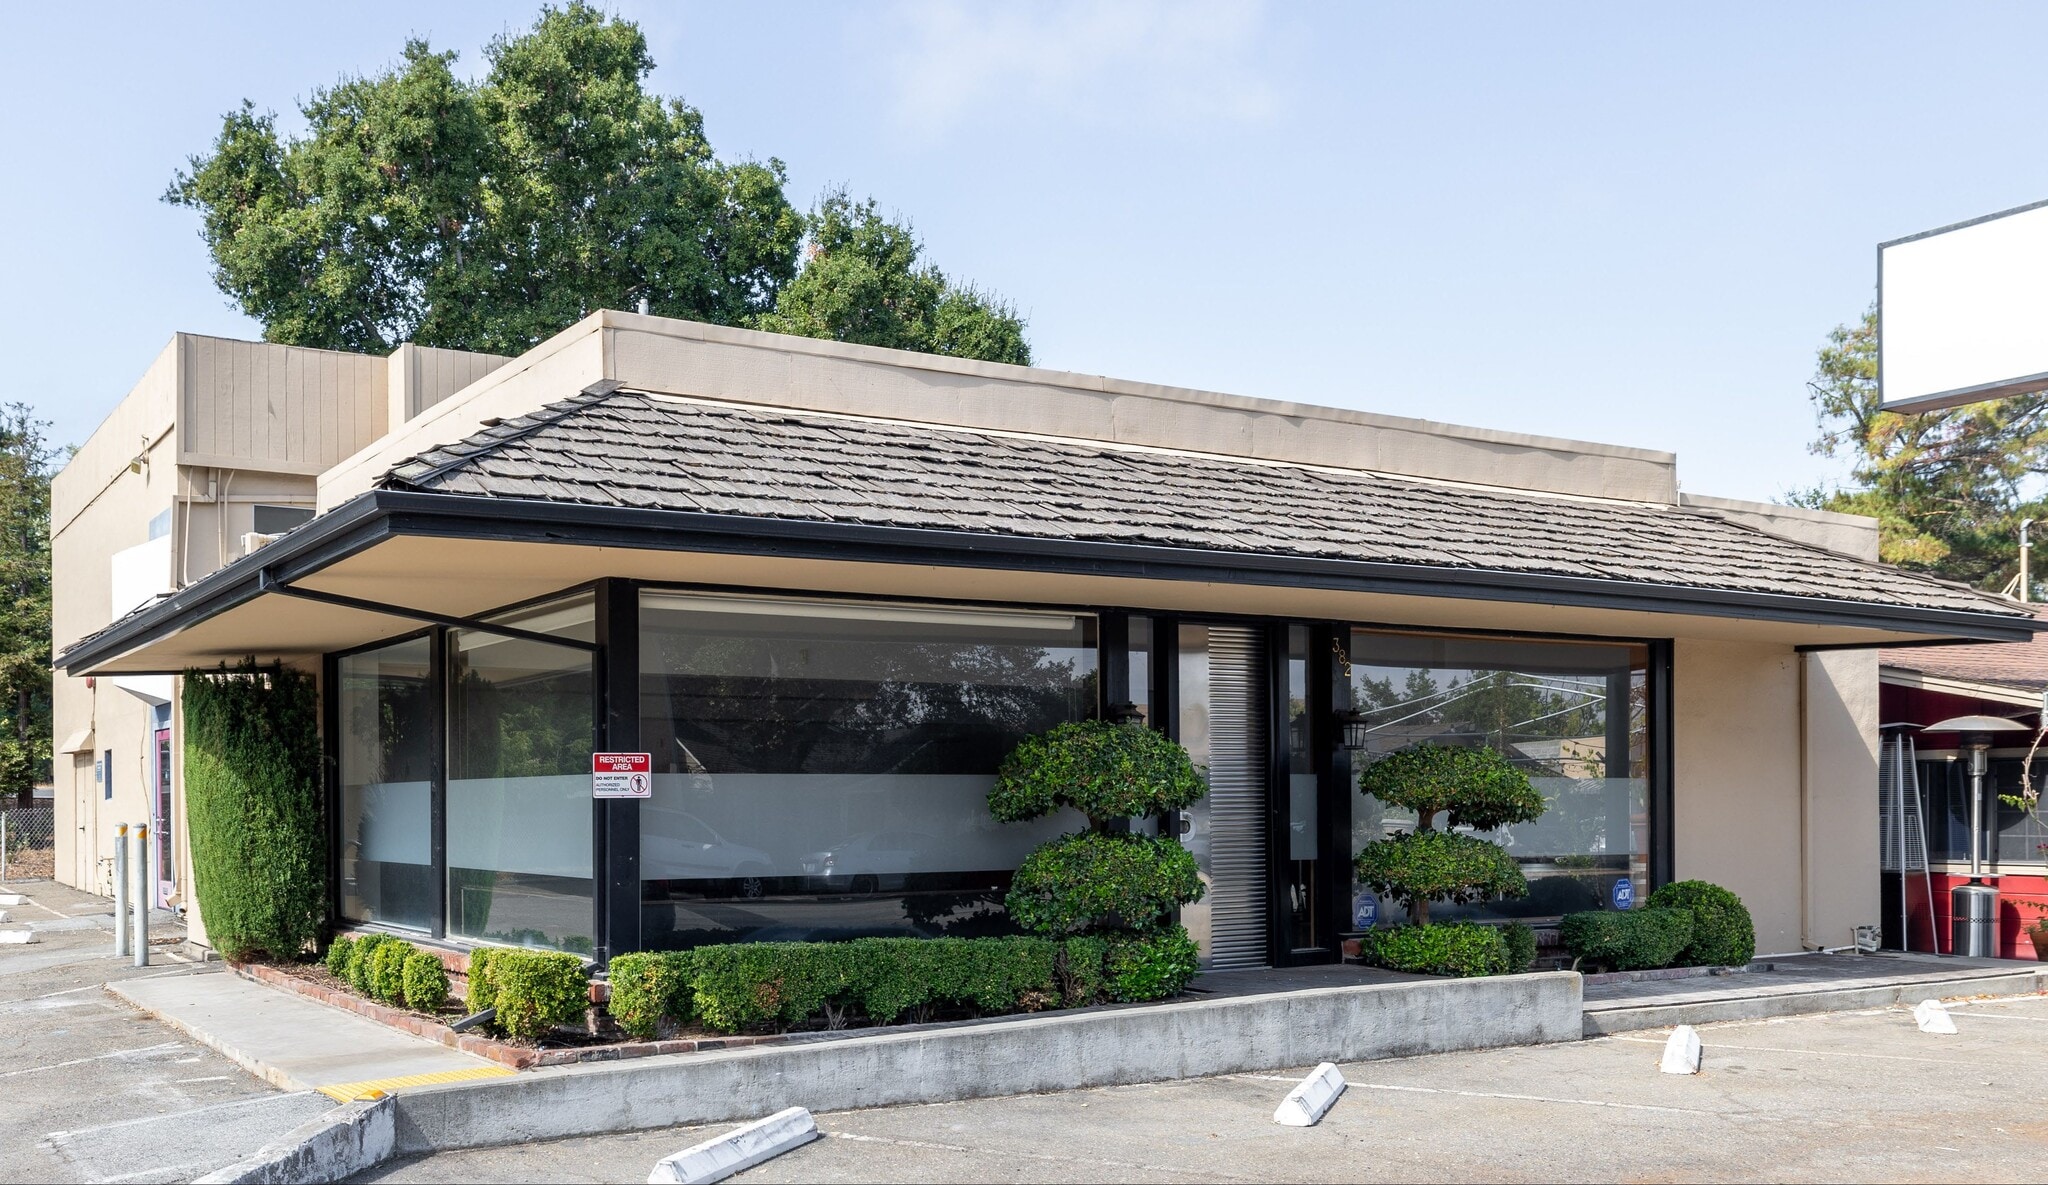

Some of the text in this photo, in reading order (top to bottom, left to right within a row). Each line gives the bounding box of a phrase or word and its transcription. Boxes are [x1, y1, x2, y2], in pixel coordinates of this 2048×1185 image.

[1332, 637, 1351, 677] 382
[1617, 888, 1630, 900] ADT
[1358, 906, 1374, 918] ADT
